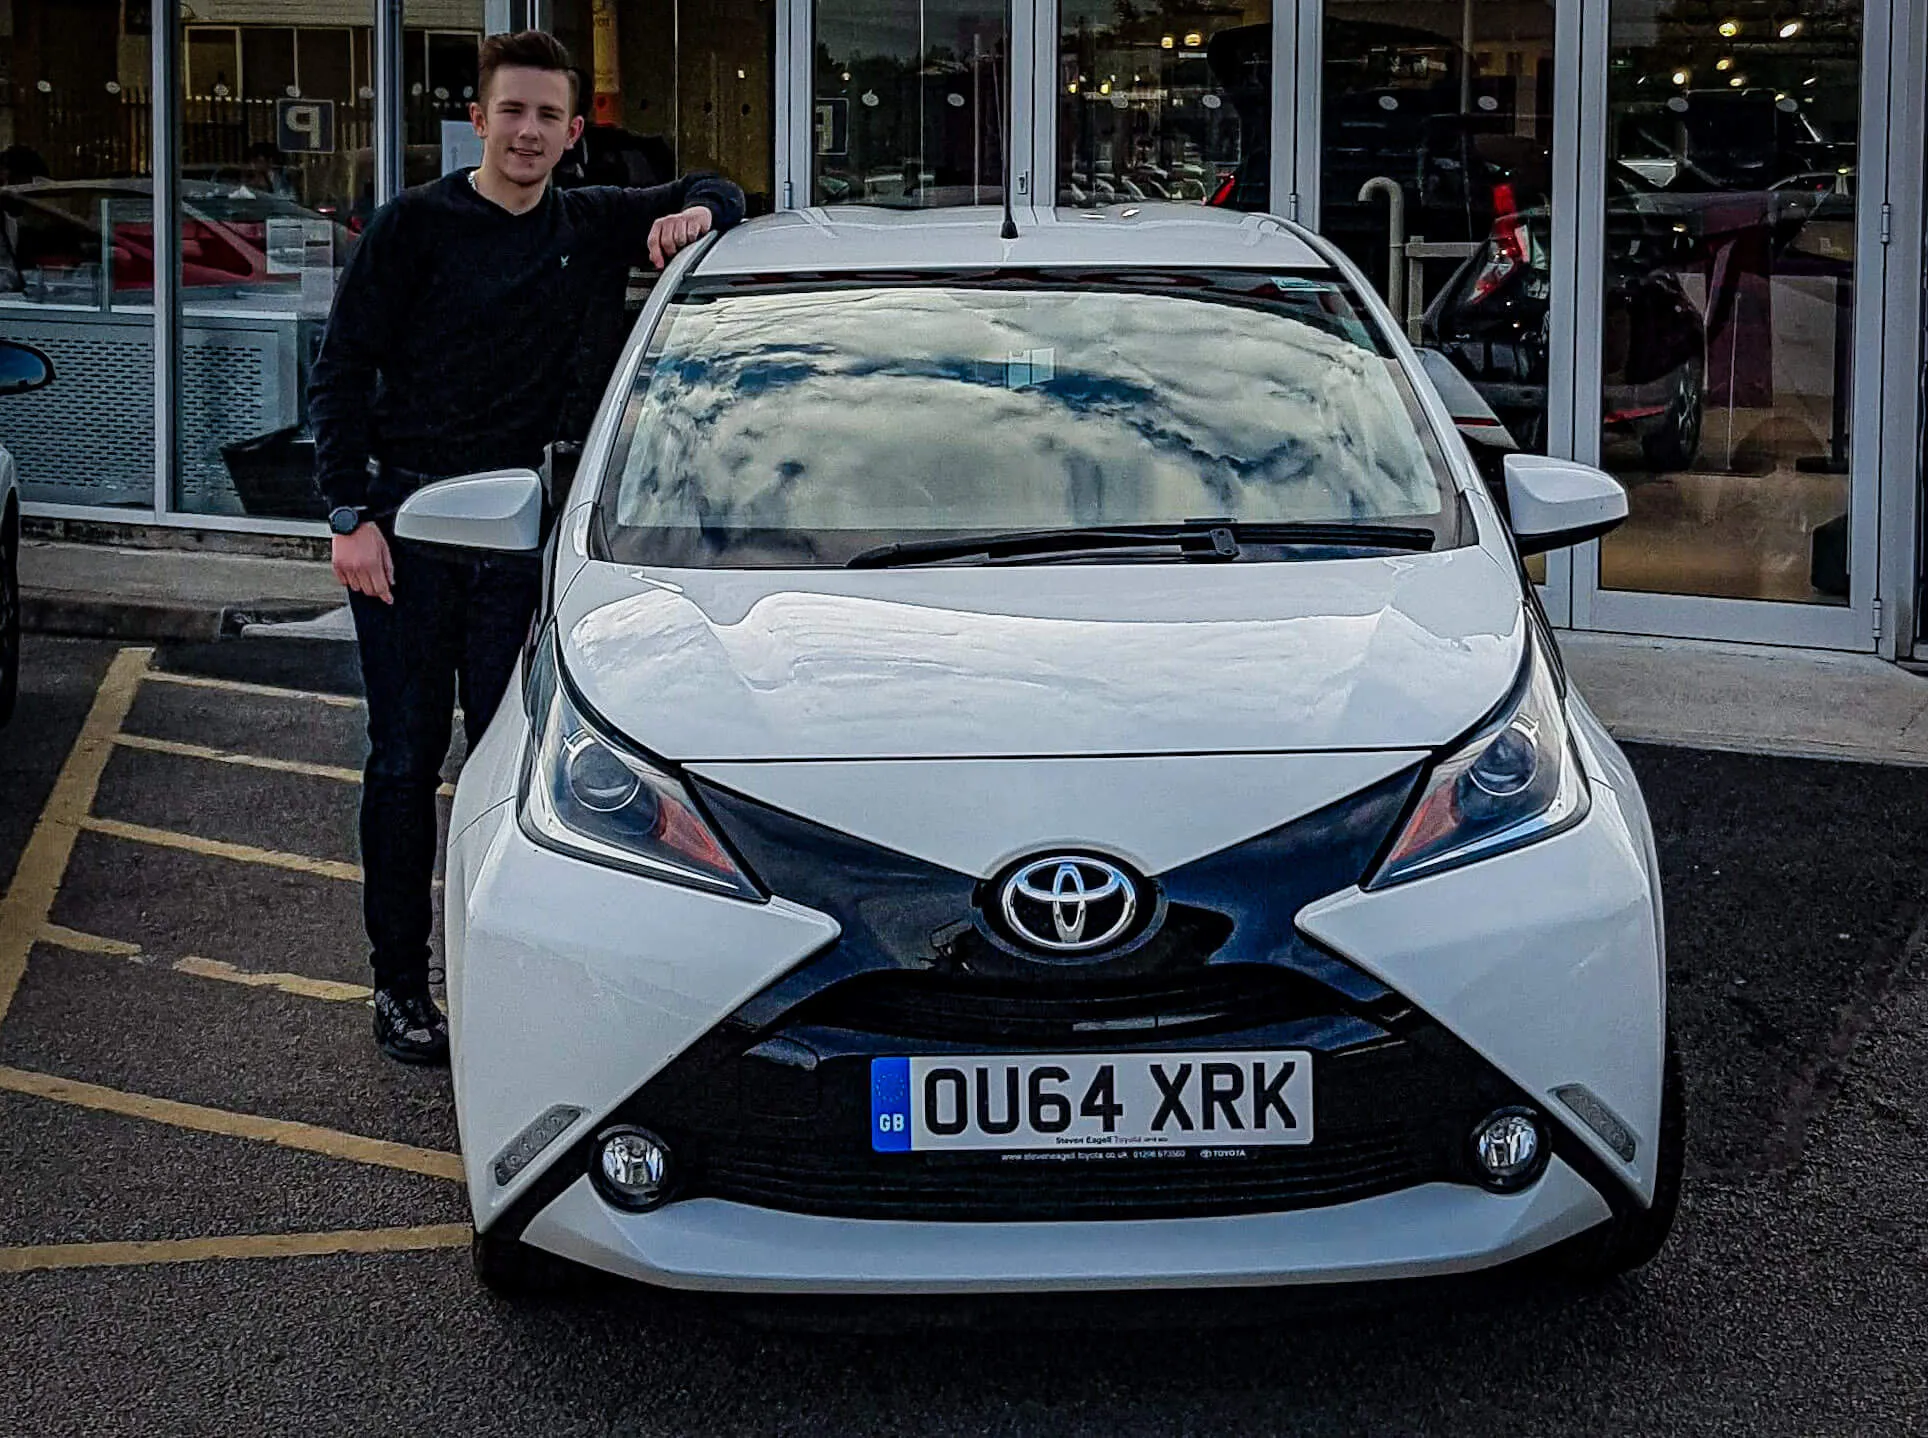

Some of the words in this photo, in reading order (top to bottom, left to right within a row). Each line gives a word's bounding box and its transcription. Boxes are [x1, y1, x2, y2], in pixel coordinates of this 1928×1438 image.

[924, 1065, 1124, 1136] OU64
[1149, 1061, 1297, 1131] XRK
[879, 1113, 905, 1133] GB
